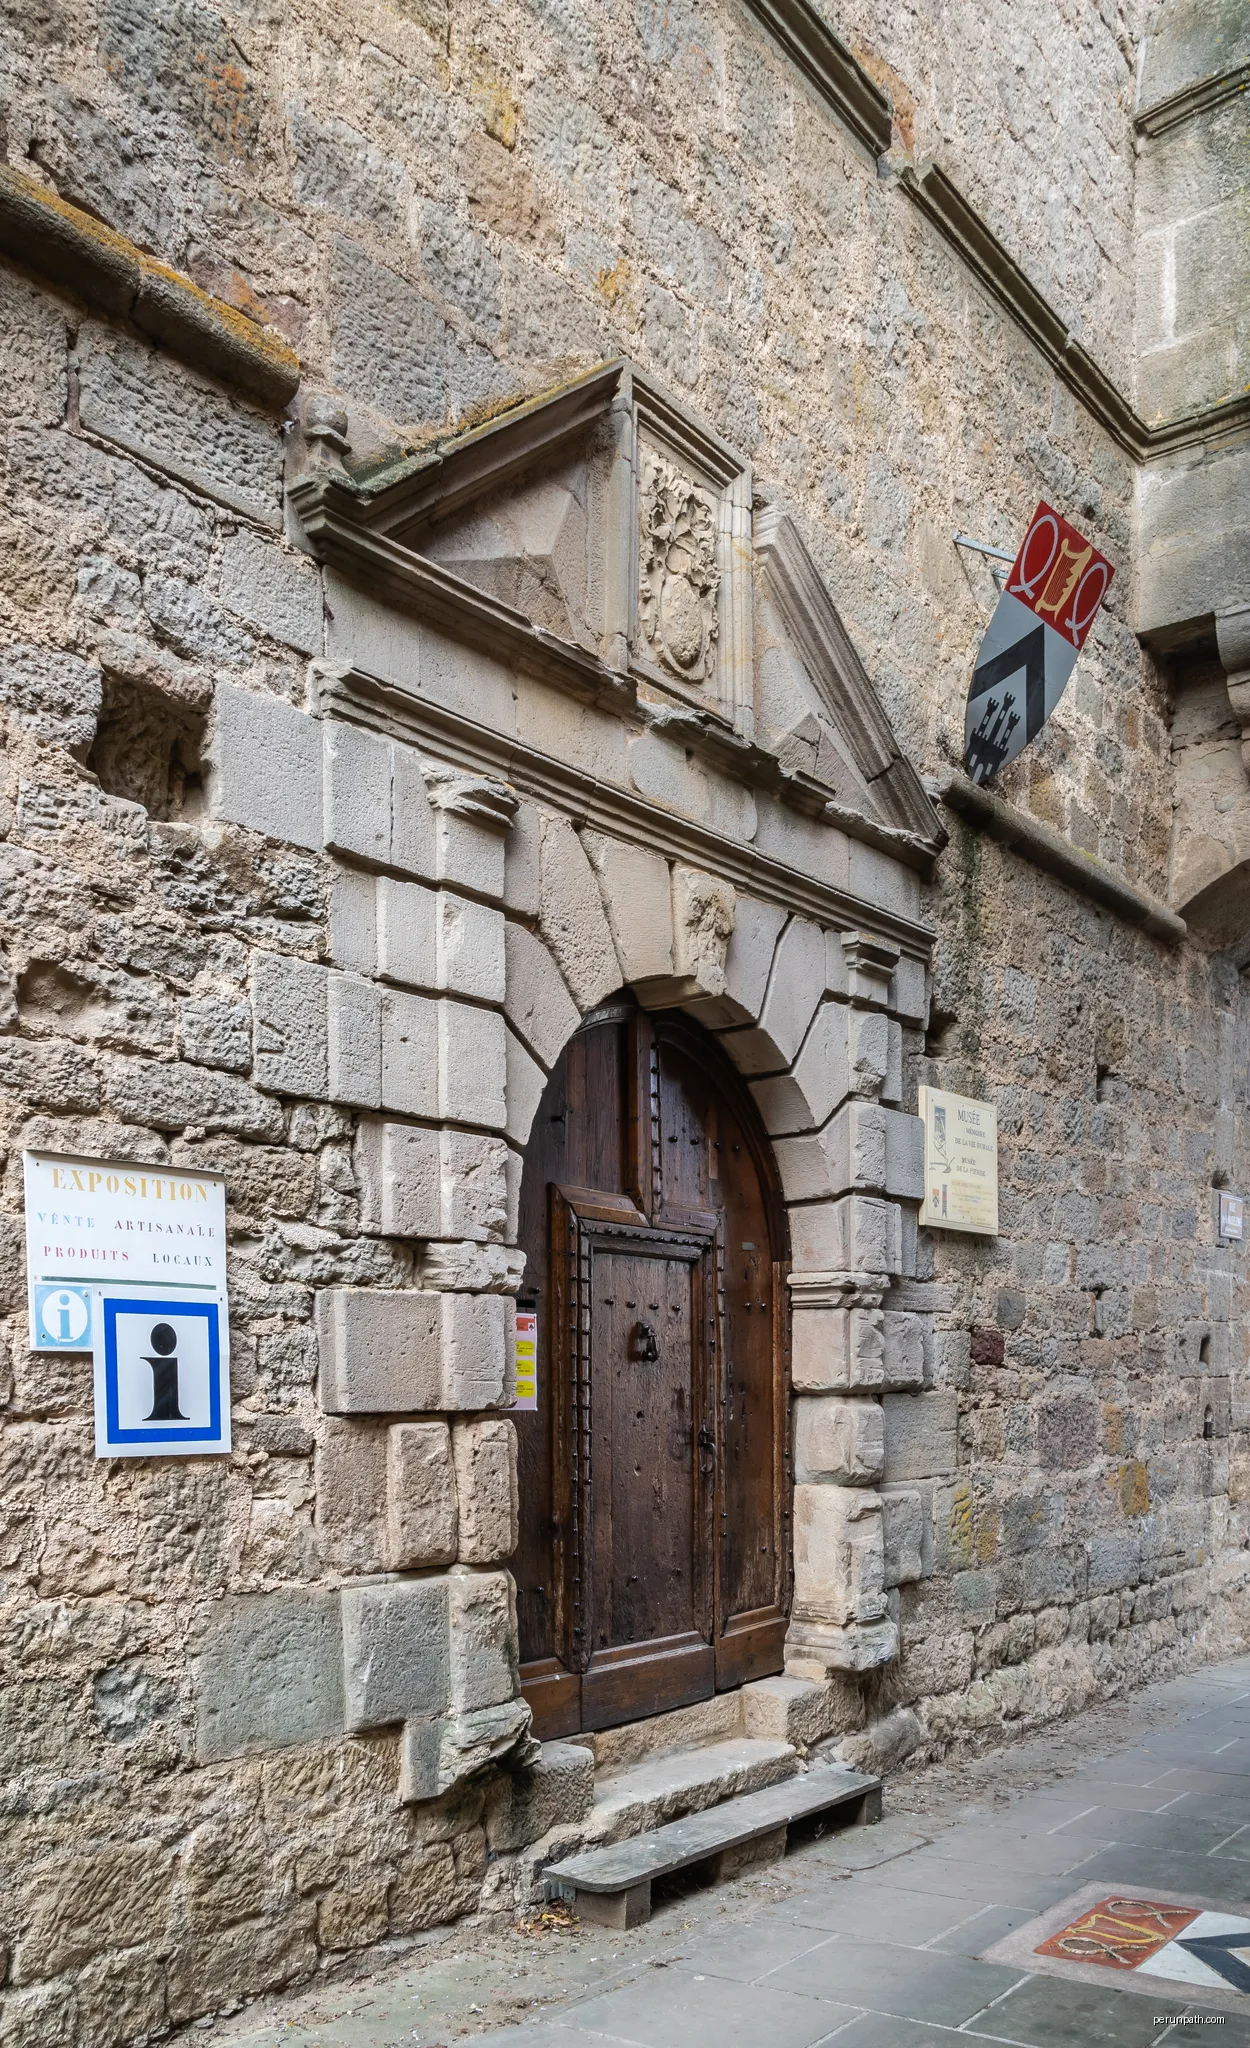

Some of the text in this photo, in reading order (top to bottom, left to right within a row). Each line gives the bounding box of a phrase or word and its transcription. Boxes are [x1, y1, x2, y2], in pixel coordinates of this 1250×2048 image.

[957, 1109, 981, 1126] MUSÉE
[52, 1168, 207, 1202] EXPOSITION
[43, 1245, 129, 1262] PRODUITS
[153, 1253, 213, 1267] LOCAUX
[139, 1322, 191, 1422] i
